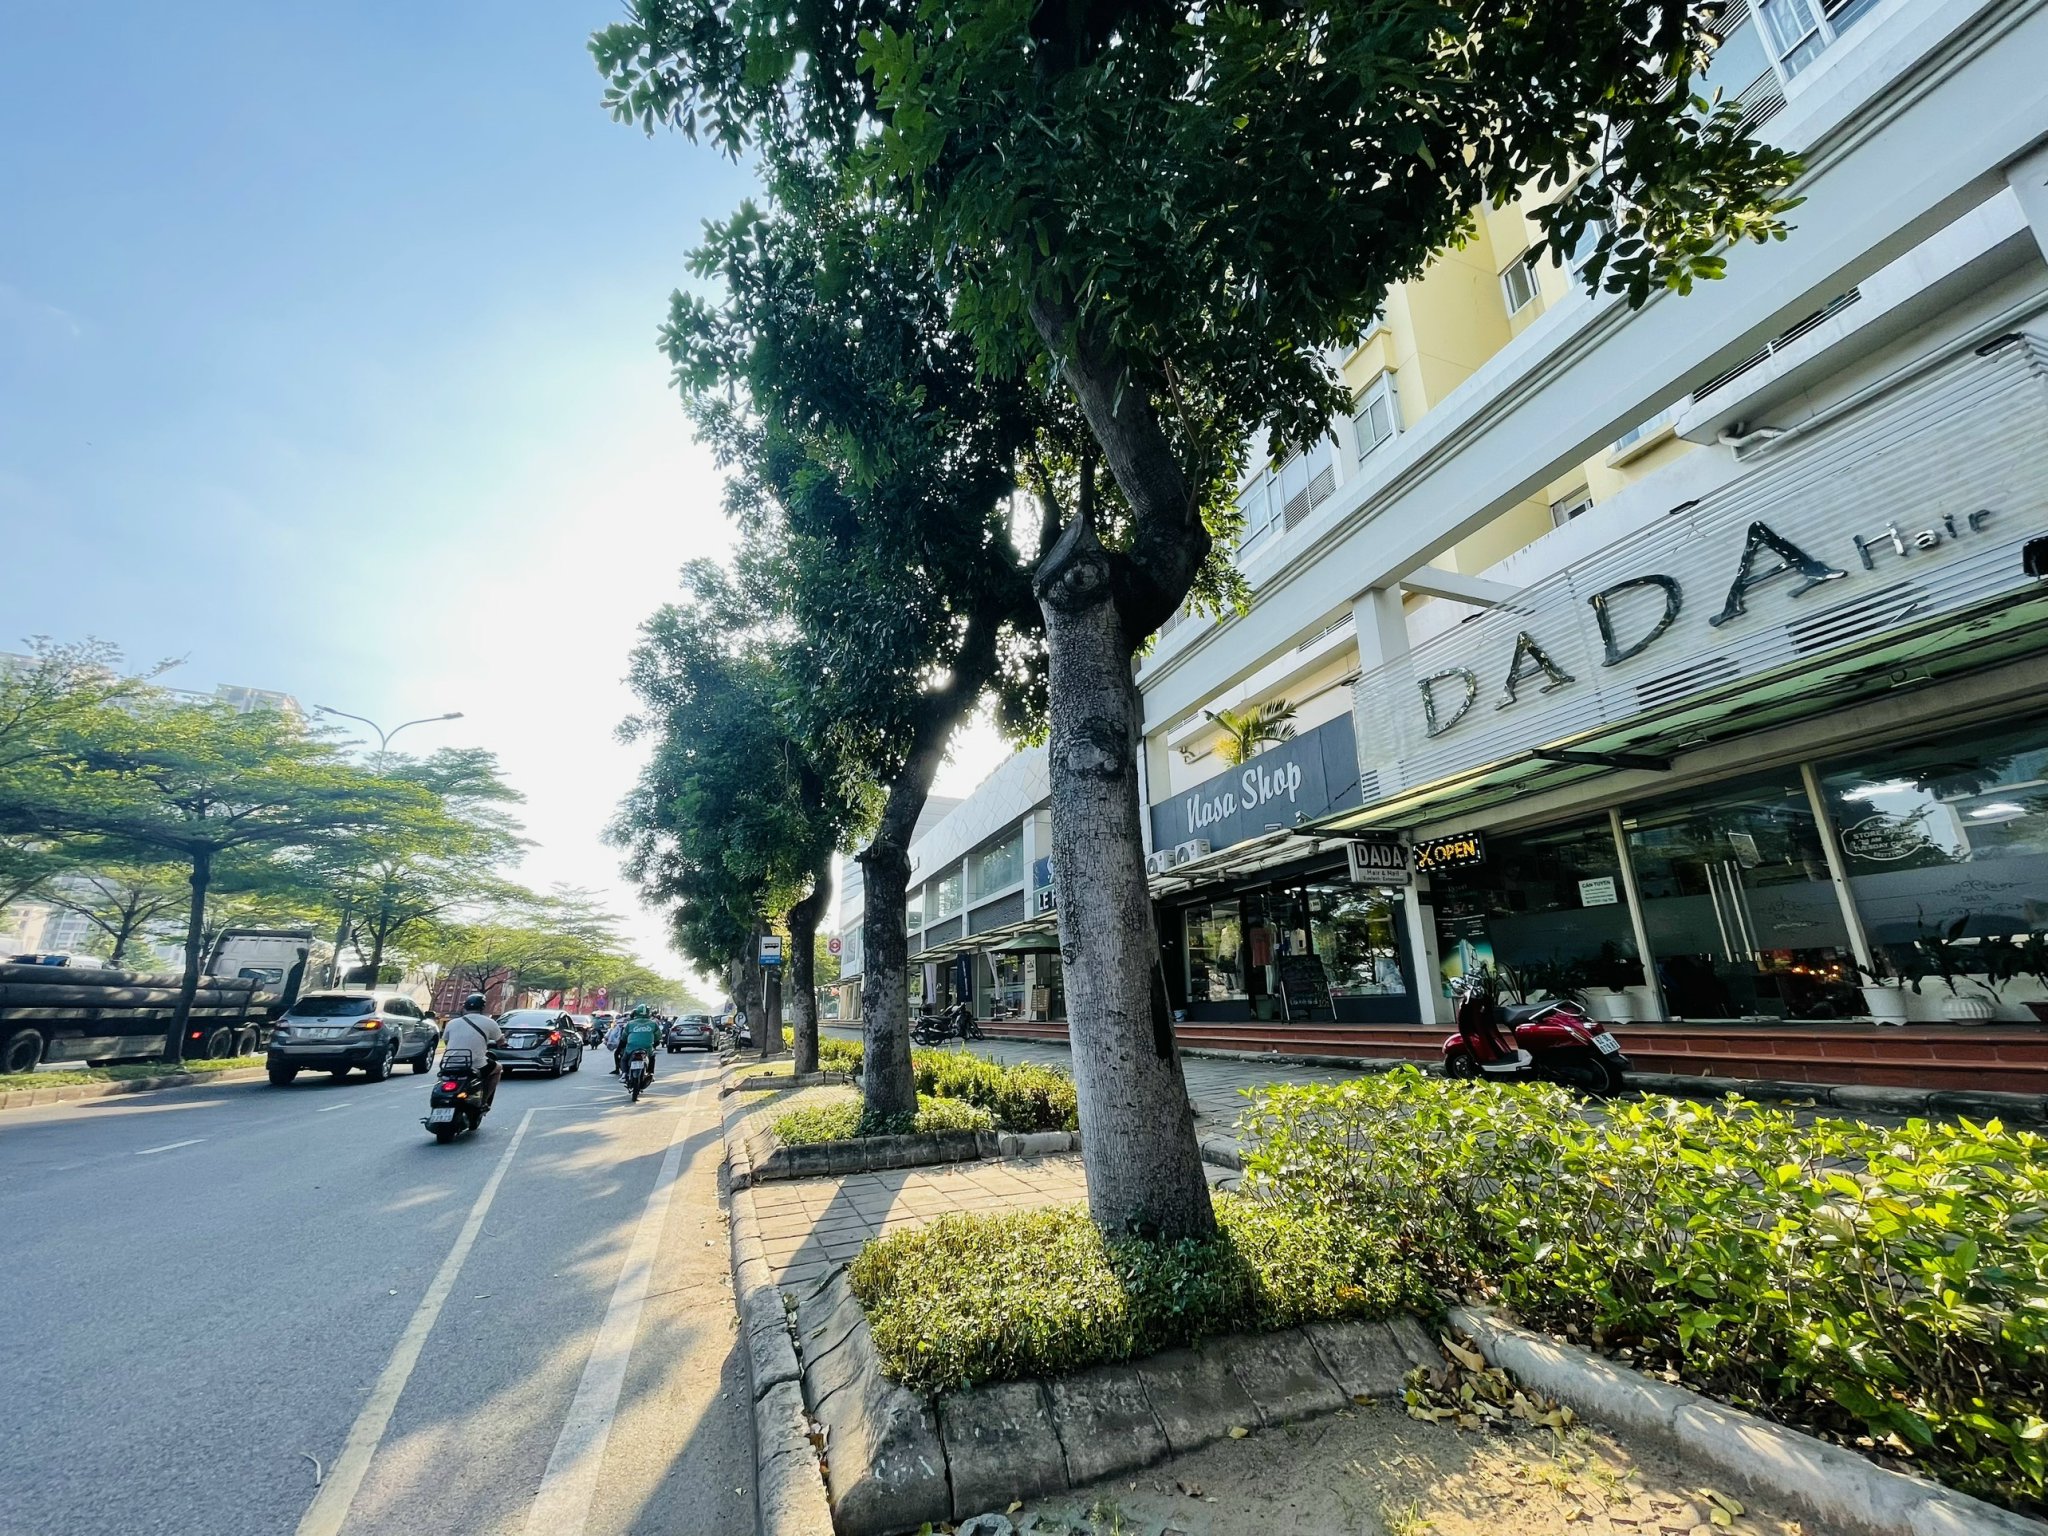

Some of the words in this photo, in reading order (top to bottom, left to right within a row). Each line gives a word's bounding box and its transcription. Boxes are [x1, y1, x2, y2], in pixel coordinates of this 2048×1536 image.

[1418, 520, 1848, 738] DADA
[1853, 509, 1990, 570] Hair
[1186, 791, 1238, 833] Nasa
[1240, 761, 1302, 810] Shop
[1853, 829, 1884, 839] STORE
[1356, 844, 1404, 867] DADA
[1434, 839, 1476, 862] OPEN
[1853, 842, 1888, 851] TUESDAY
